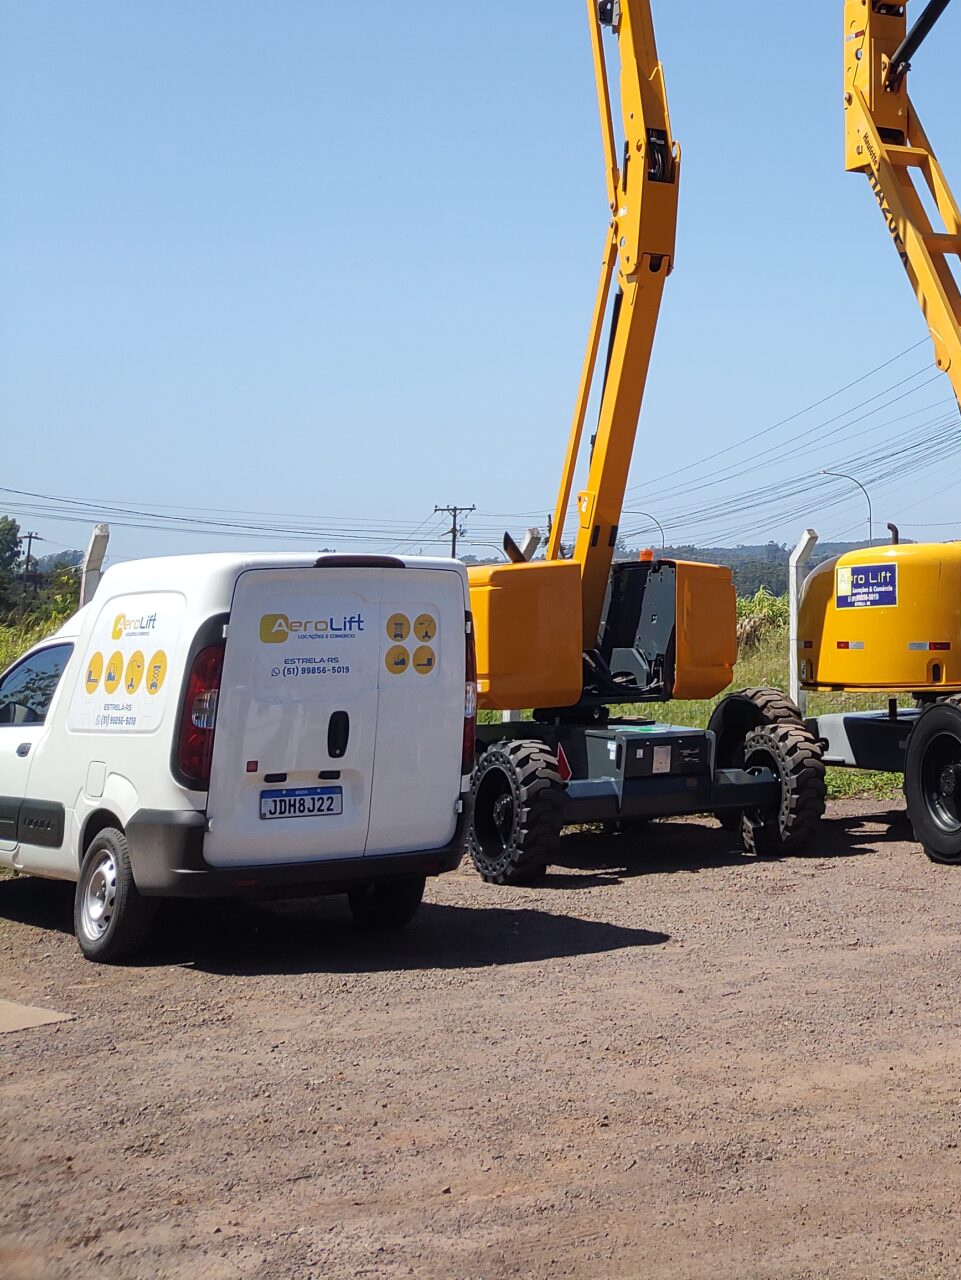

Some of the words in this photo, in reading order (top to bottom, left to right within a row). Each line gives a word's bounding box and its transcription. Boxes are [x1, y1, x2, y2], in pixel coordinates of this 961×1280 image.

[862, 131, 879, 166] Haulotte
[869, 571, 891, 583] Lift
[117, 612, 157, 632] AeroLift
[271, 613, 364, 633] AeroLift
[284, 657, 340, 665] ESTRELA-RS
[283, 666, 299, 677] (51)
[300, 666, 350, 675] 99856-5019
[268, 796, 335, 816] JDH8J22
